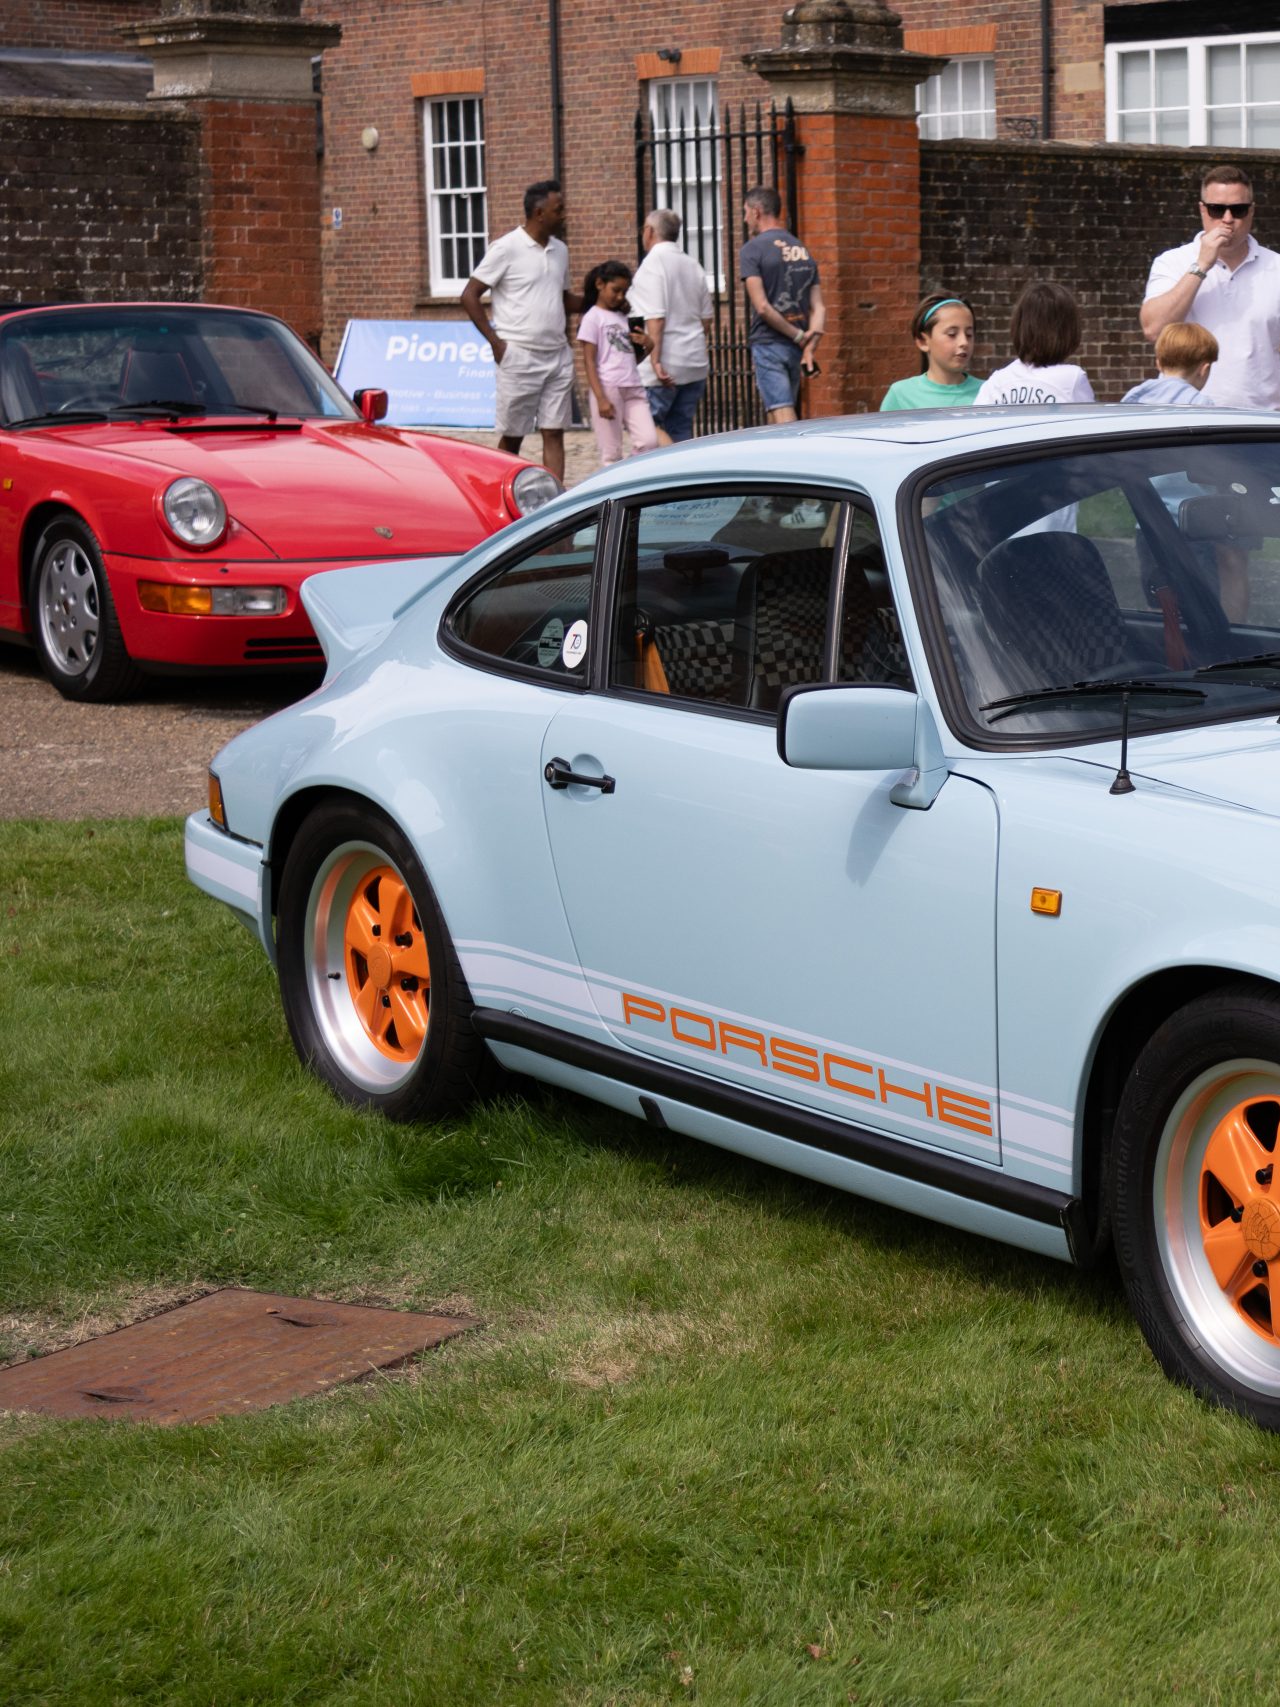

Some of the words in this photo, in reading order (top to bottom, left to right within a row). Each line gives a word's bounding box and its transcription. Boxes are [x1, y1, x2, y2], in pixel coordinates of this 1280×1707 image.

[385, 333, 494, 363] Pionee
[458, 365, 494, 378] Finan
[995, 386, 1056, 405] ADDISO
[620, 992, 993, 1137] PORSCHE
